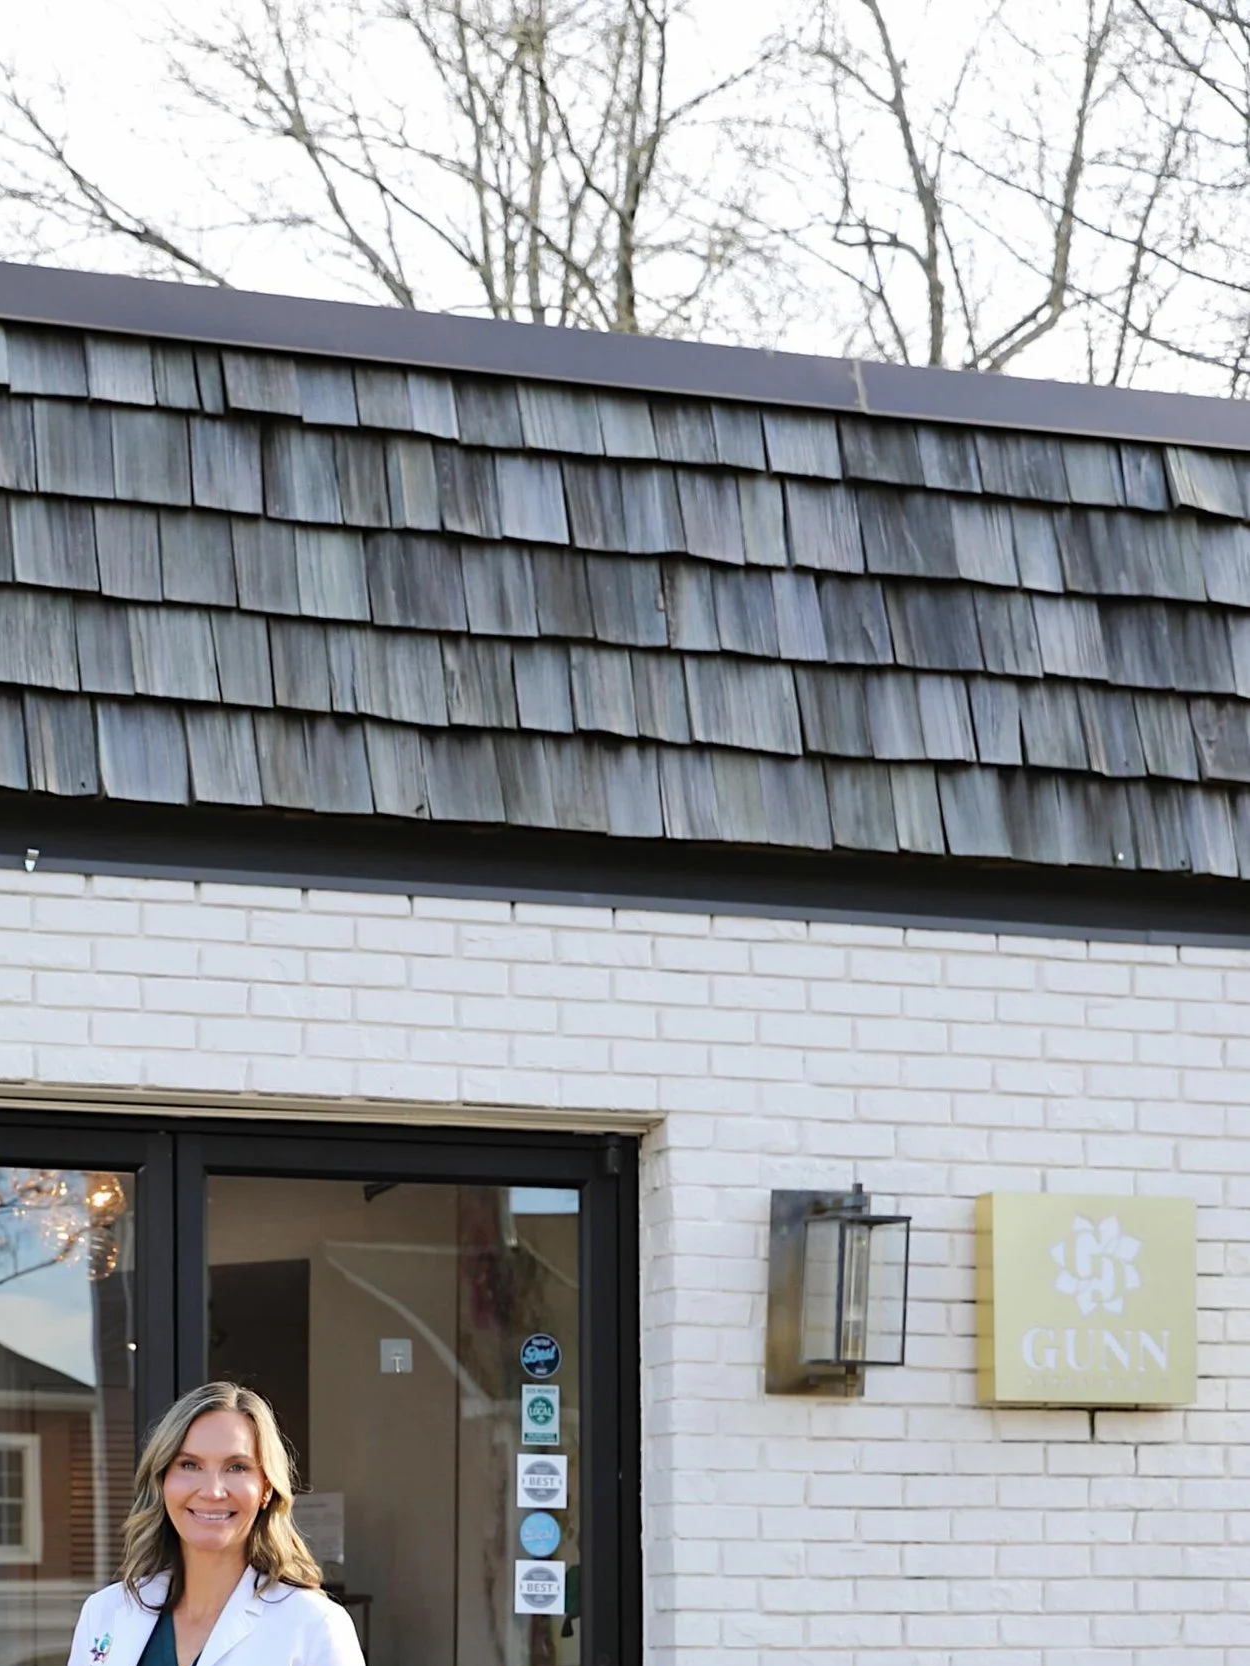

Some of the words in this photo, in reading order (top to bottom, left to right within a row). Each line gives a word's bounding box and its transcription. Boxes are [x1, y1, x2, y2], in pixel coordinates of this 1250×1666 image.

[1022, 1326, 1170, 1372] GUNN
[529, 1476, 554, 1487] BEST
[527, 1582, 553, 1593] BEST
